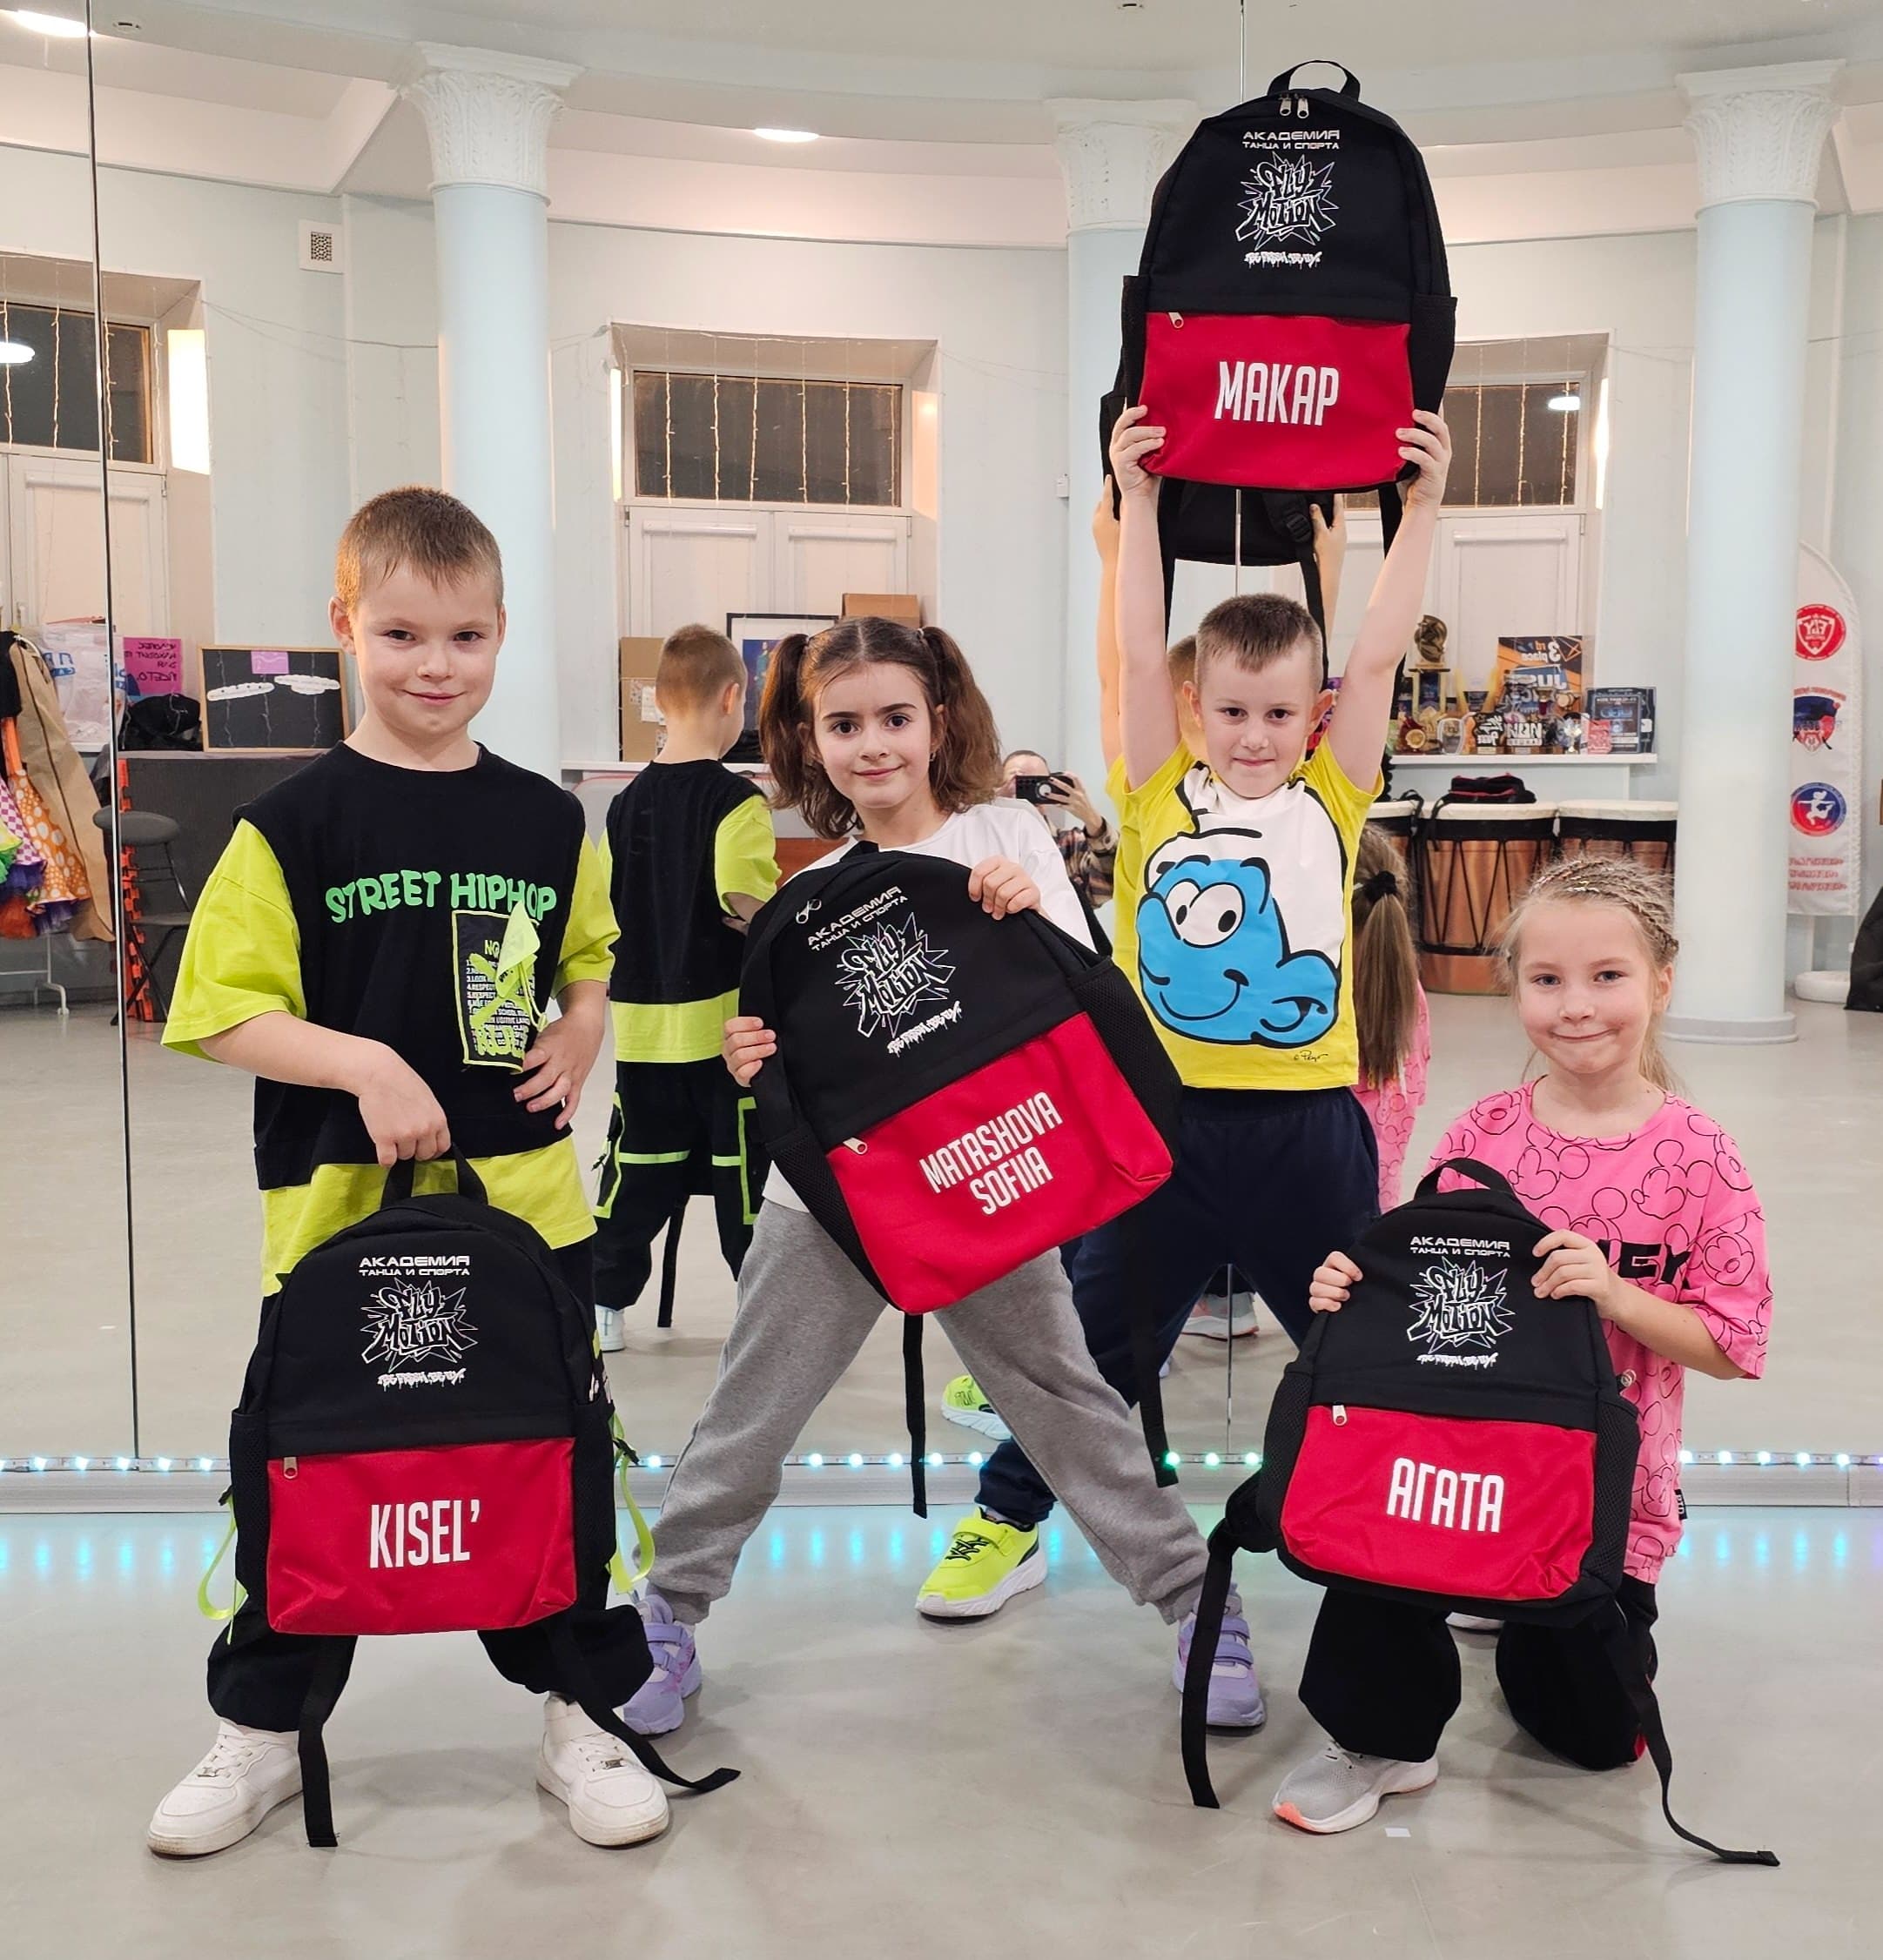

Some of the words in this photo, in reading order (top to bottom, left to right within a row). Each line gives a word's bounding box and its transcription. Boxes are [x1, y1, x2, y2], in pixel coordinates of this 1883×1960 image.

[1242, 141, 1280, 150] ТАНЦА
[1243, 130, 1341, 140] АКАДЕМИЯ
[1214, 361, 1340, 426] МАКАР
[326, 869, 441, 923] STREET
[807, 885, 903, 946] АКАДЕМИЯ
[811, 928, 851, 952] ТАНЦА
[864, 896, 909, 923] СПОРТА
[919, 1091, 1064, 1193] MATASHOVA
[969, 1146, 1053, 1215] SOFIIA
[359, 1255, 470, 1267] АКАДЕМИЯ
[1410, 1236, 1510, 1250] АКАДЕМИЯ
[1464, 1249, 1510, 1258] СПОРТА
[1387, 1457, 1504, 1533] АГАТА
[370, 1499, 481, 1567] KISEL'
